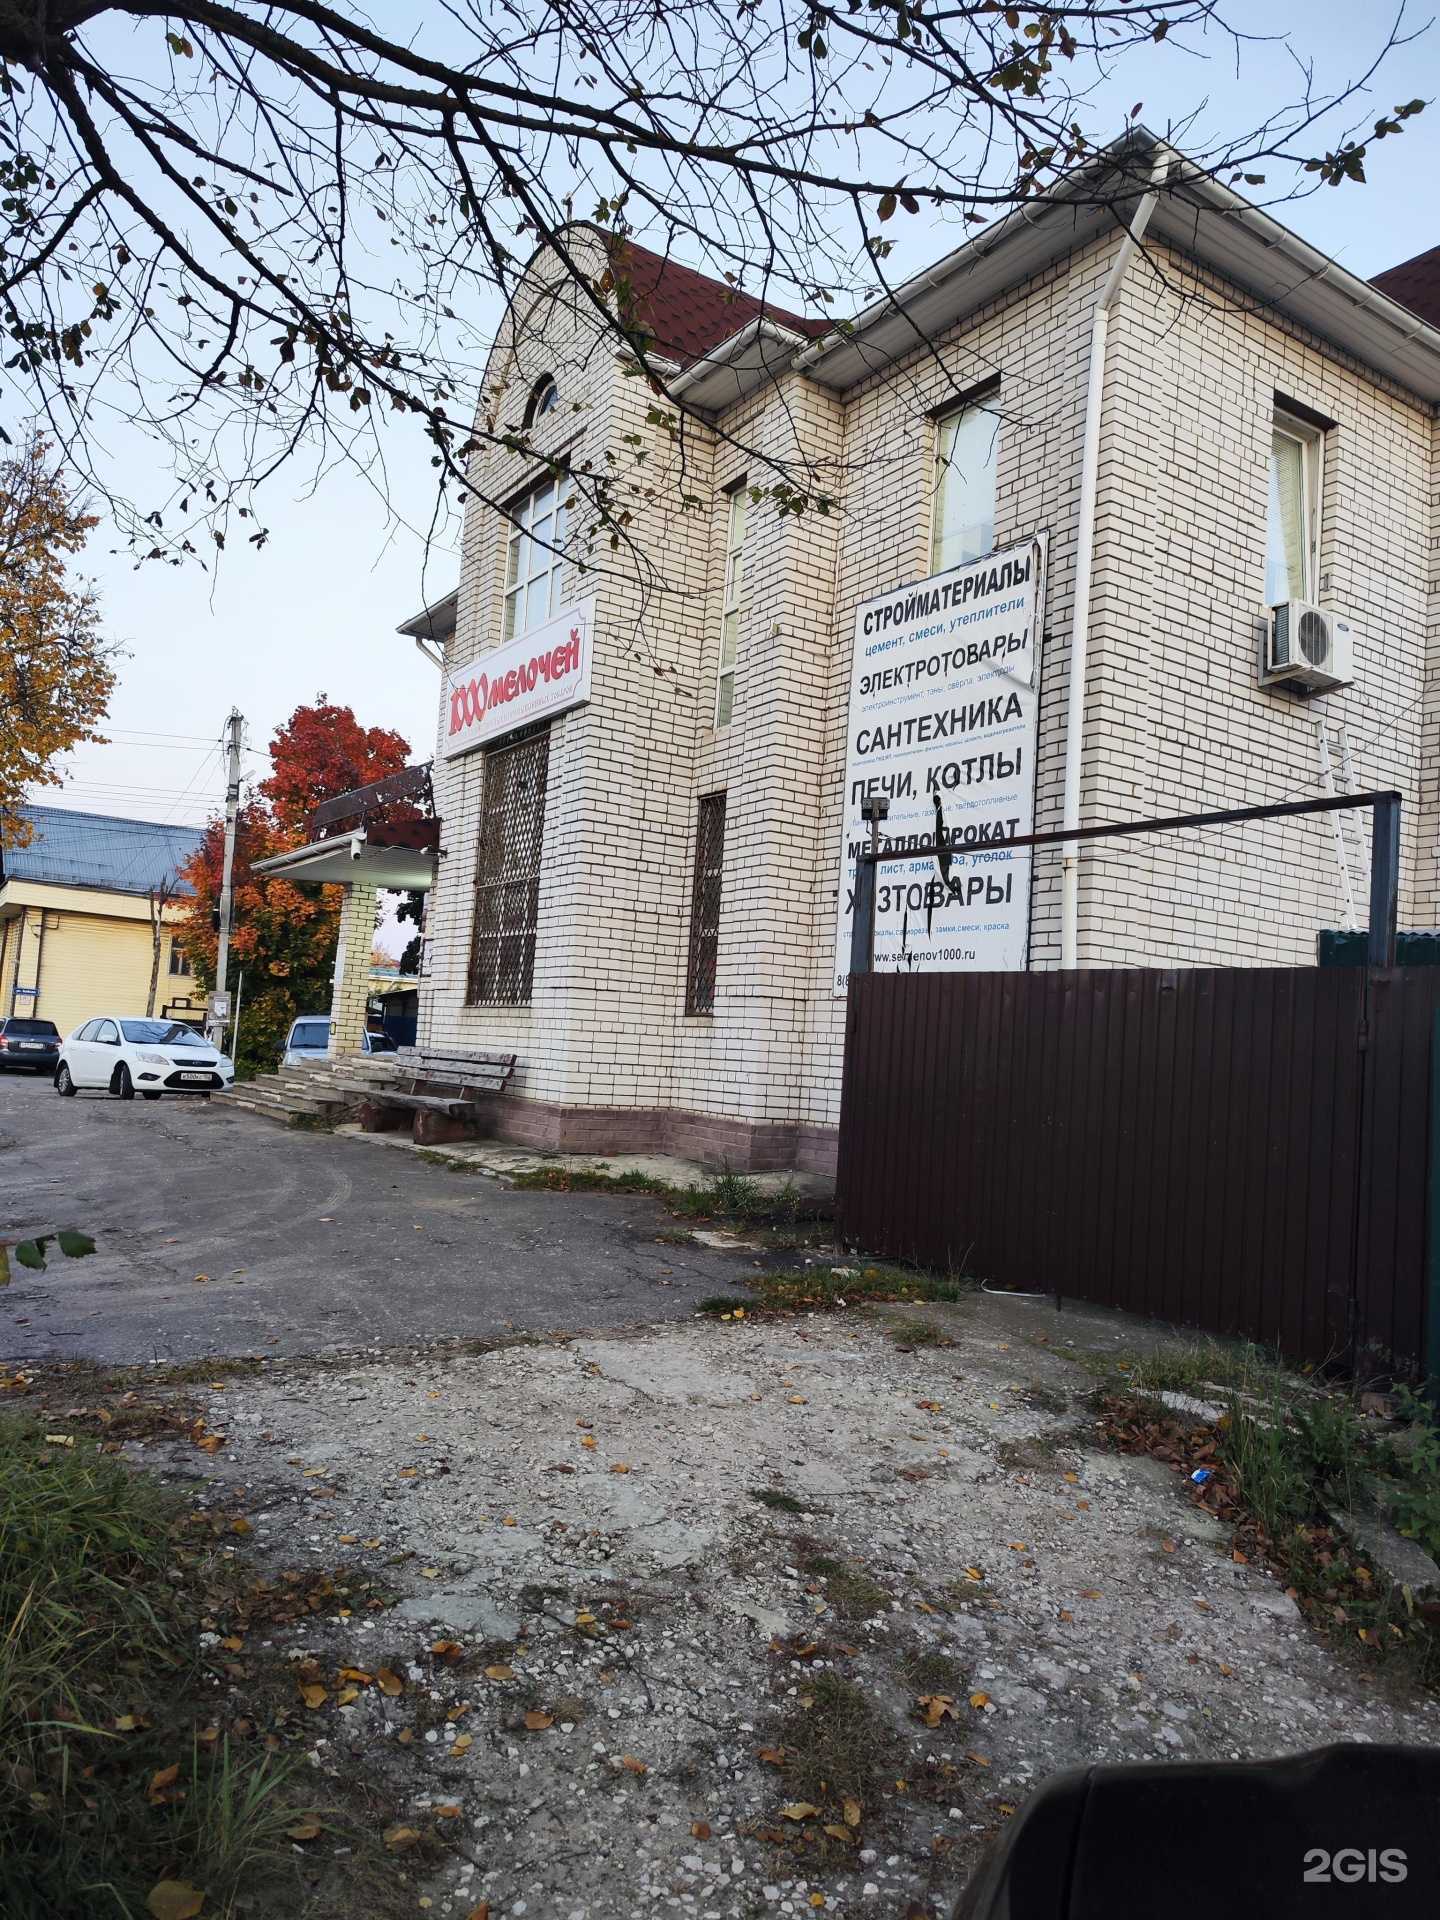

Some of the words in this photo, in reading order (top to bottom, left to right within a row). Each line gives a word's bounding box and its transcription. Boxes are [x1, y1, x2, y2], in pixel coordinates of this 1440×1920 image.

[863, 555, 1031, 636] СТРОЙМАТЕРИАЛЫ
[865, 635, 905, 657] цемент,
[908, 622, 946, 643] смеси,
[950, 597, 1025, 633] утеплители
[859, 628, 1029, 696] ЭЛЕКТРОТОВАРЫ
[856, 692, 1023, 756] САНТЕХНИКА
[851, 770, 917, 806] ПЕЧИ,
[925, 747, 1022, 794] КОТЛЫ
[908, 855, 968, 874] армара,
[970, 850, 1015, 869] уголок
[844, 873, 1013, 915] ХЗТОВАРЫ
